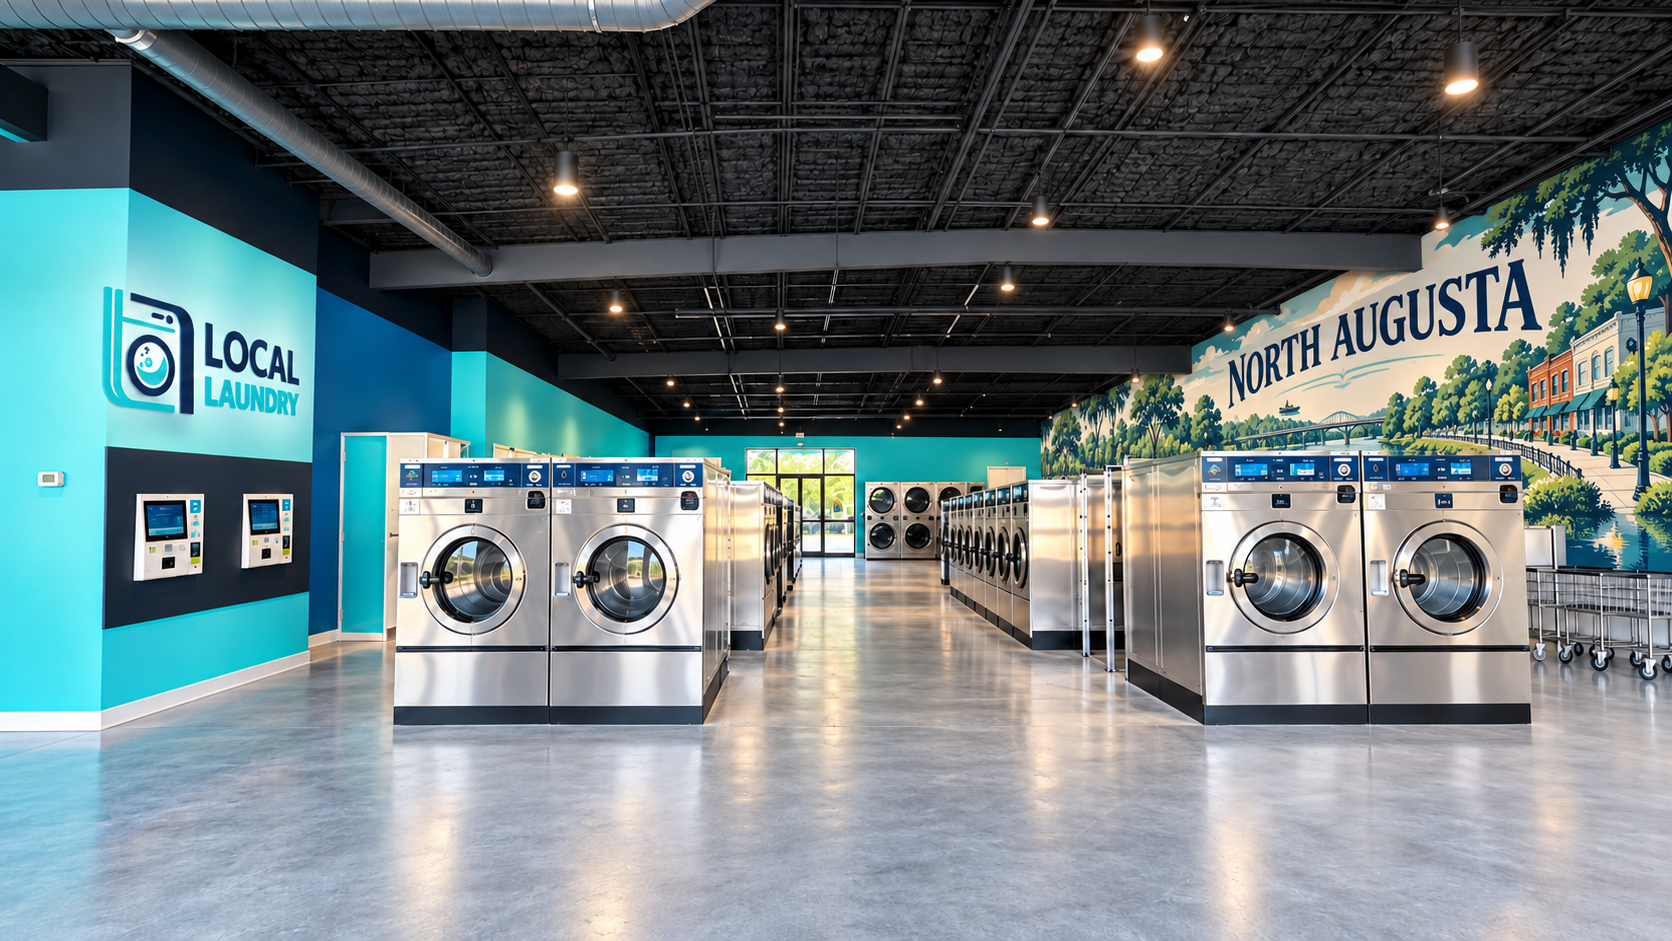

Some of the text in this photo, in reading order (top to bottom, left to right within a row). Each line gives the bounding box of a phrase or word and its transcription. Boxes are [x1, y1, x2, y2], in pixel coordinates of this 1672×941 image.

[204, 322, 300, 386] LOCAL
[1228, 258, 1543, 409] NORTH AUGUSTA
[204, 376, 300, 417] LAUNDRY
